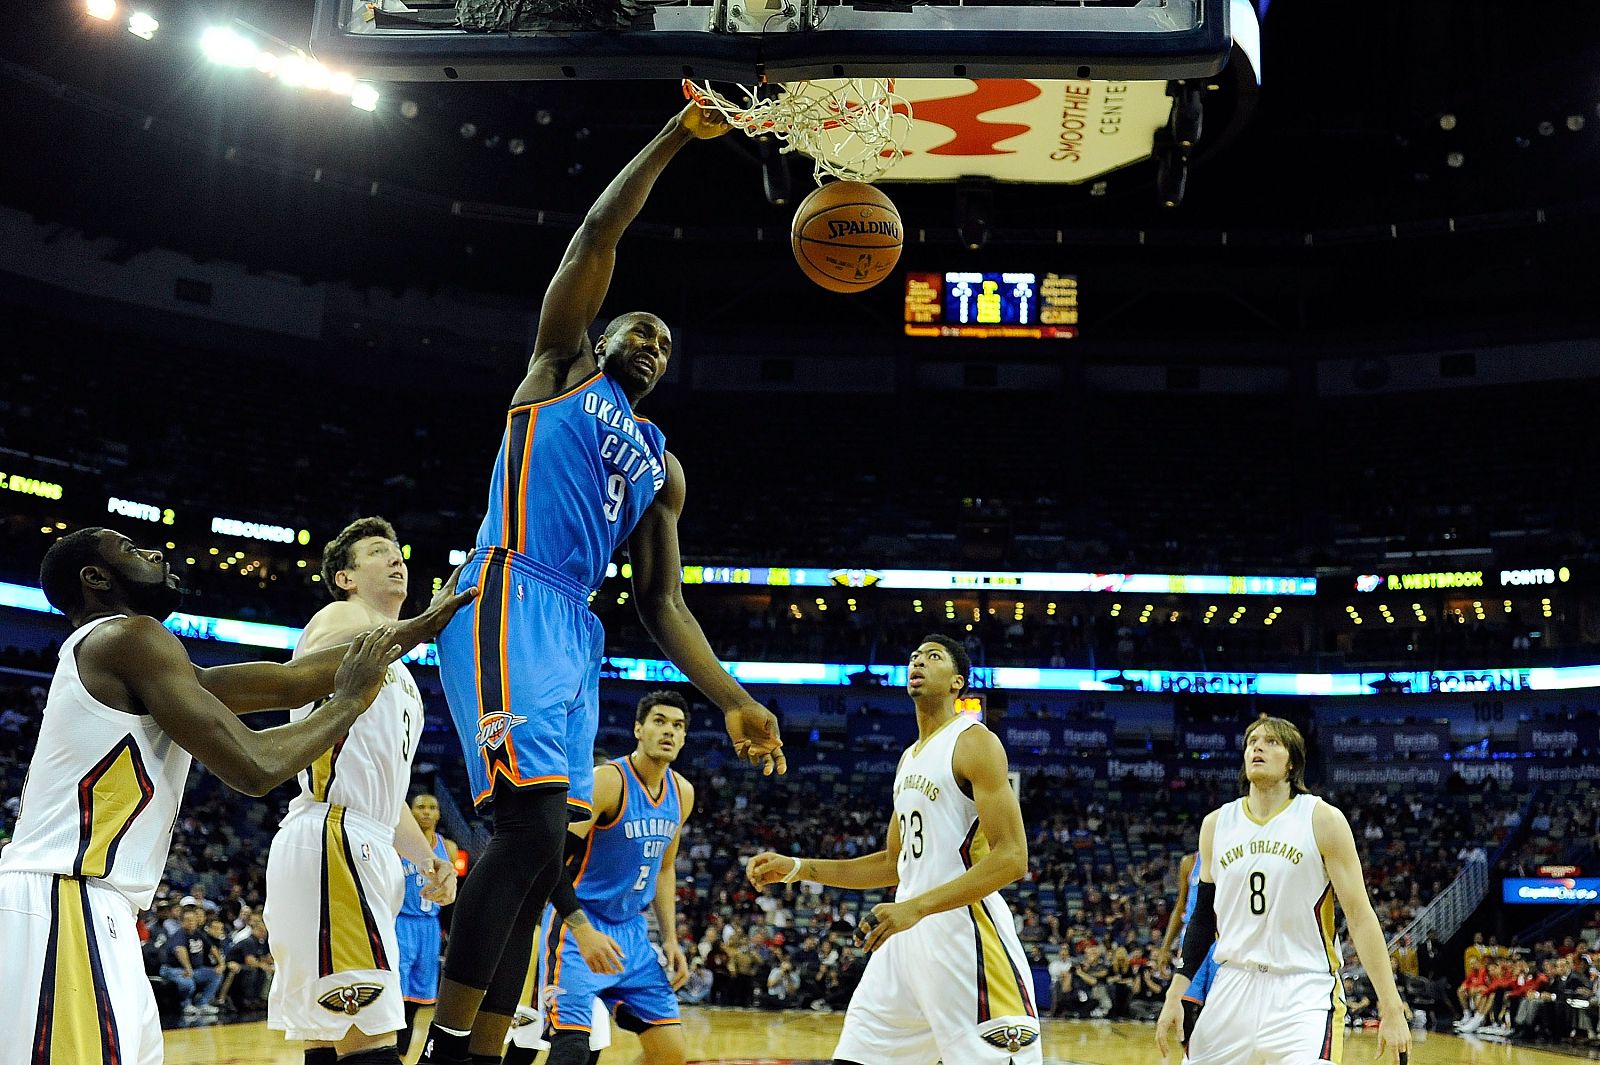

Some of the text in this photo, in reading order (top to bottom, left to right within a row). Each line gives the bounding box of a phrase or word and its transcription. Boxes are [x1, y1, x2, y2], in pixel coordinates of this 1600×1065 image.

[1050, 84, 1091, 162] SMOOTHIE
[1099, 80, 1127, 135] CENTE
[827, 220, 898, 240] SPALDING
[600, 433, 651, 483] CITY
[603, 473, 626, 522] 9
[108, 497, 161, 522] POINTS
[163, 509, 175, 525] 2
[212, 517, 295, 544] REBOUNDS
[1500, 569, 1555, 586] POINTS
[402, 707, 411, 762] 3
[643, 840, 665, 858] CIT
[1219, 840, 1304, 870] NEW ORLEANS
[633, 864, 650, 891] 2
[1249, 871, 1266, 915] 8
